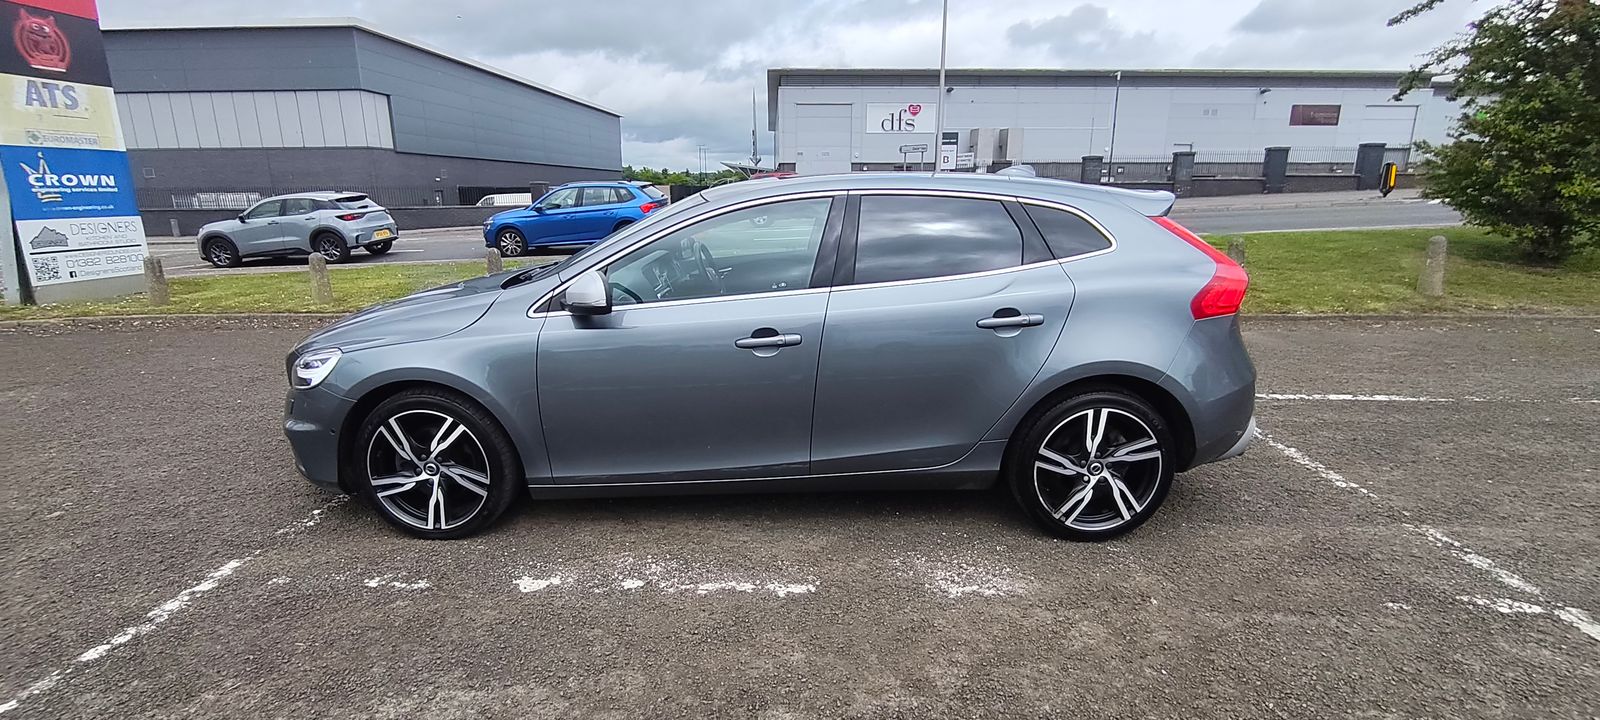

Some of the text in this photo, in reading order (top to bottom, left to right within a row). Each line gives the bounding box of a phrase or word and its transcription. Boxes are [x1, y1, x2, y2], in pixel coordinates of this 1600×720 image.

[25, 79, 79, 110] ATS
[881, 108, 916, 132] dfs
[43, 134, 98, 145] EUROMASTER
[943, 155, 950, 164] B
[28, 174, 115, 187] CROWN
[69, 221, 138, 236] DESIGNERS
[66, 257, 101, 269] 01382
